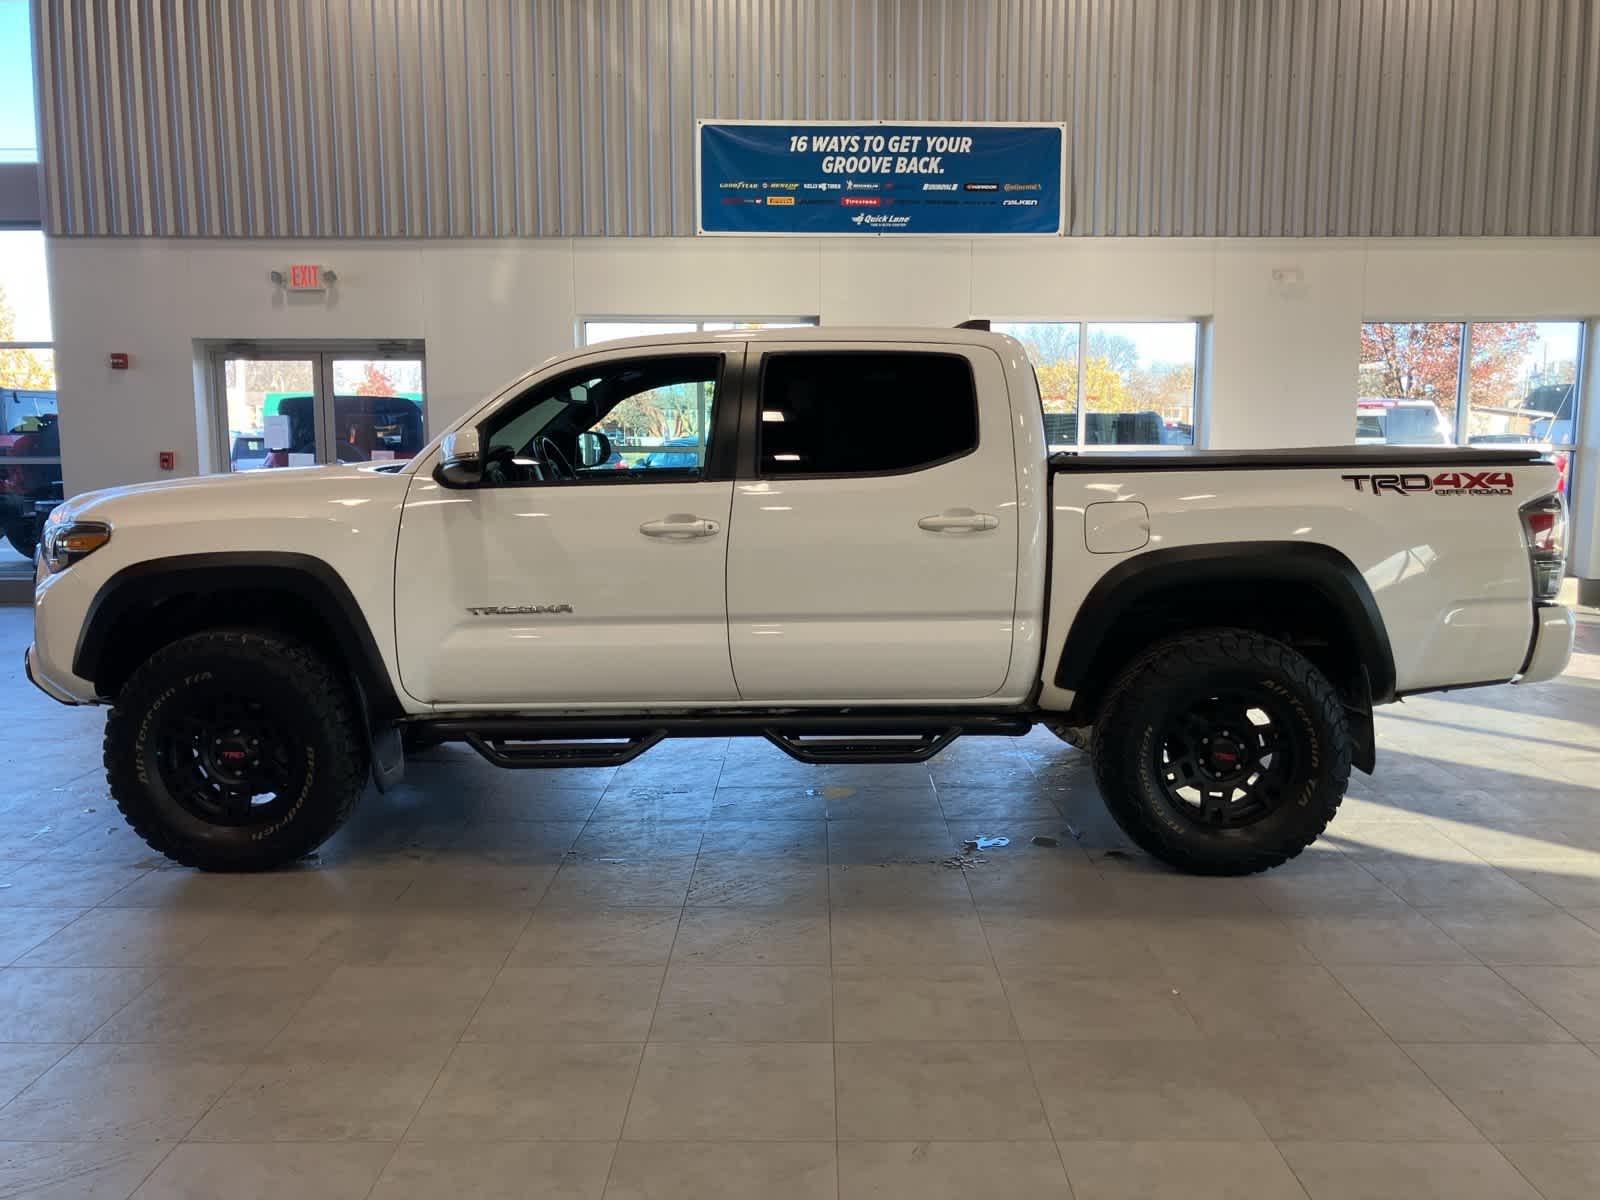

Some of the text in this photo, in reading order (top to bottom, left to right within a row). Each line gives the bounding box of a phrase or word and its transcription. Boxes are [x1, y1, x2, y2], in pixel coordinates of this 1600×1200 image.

[790, 136, 973, 153] 16 WAYS TO GET YOUR
[822, 156, 945, 174] GROOVE BACK.
[864, 214, 911, 223] Quick Lane
[290, 264, 320, 288] EXIT
[1434, 488, 1513, 496] OFF ROAD
[466, 604, 574, 615] TACOMA
